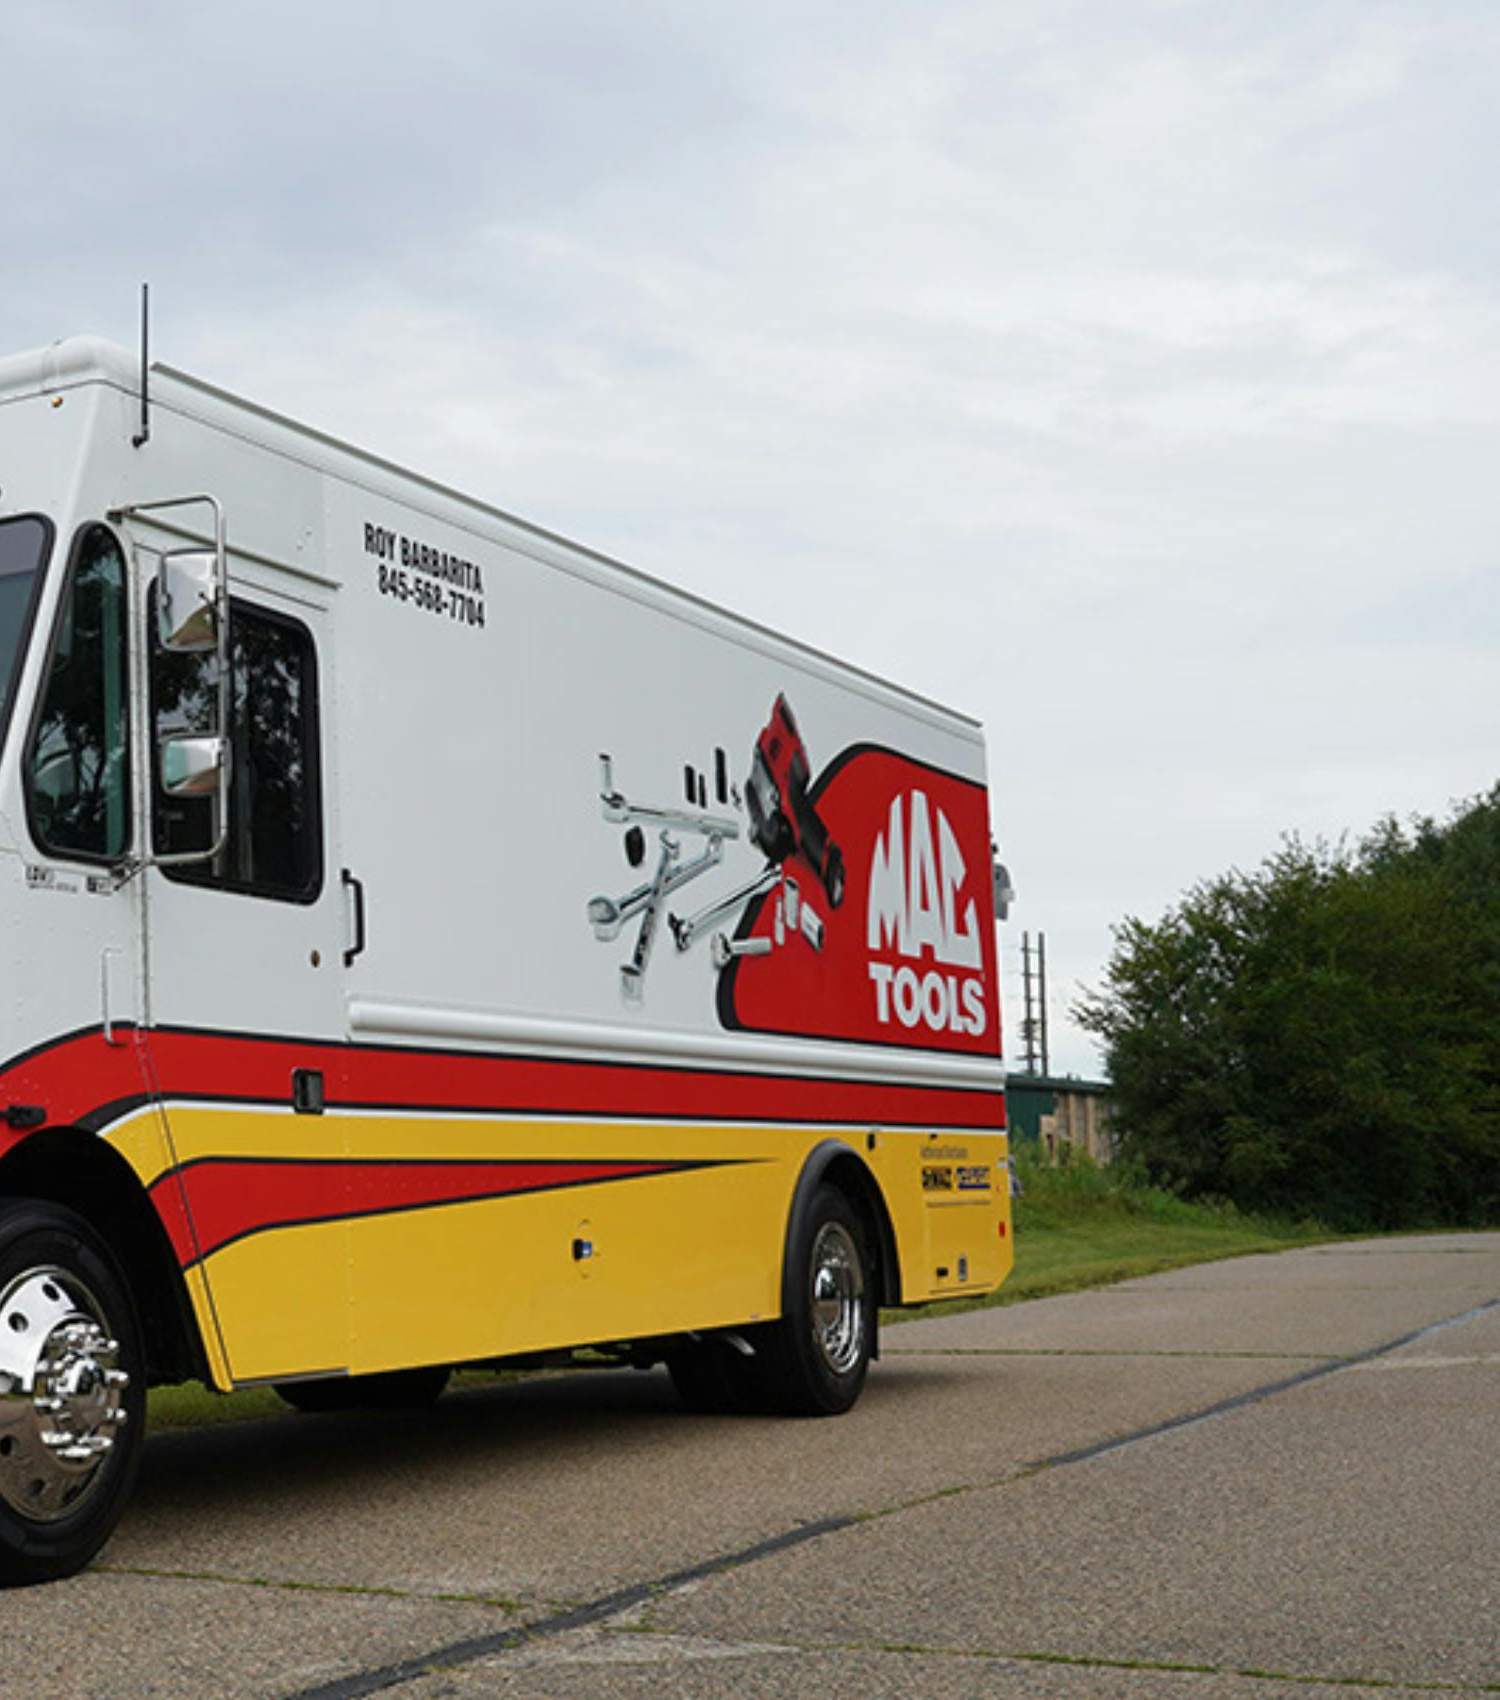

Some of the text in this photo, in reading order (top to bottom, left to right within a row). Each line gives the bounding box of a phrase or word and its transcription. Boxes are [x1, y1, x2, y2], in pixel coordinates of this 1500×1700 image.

[364, 522, 483, 594] ROY BARBARITA
[867, 789, 982, 971] MAC
[868, 961, 986, 1036] TOOLS
